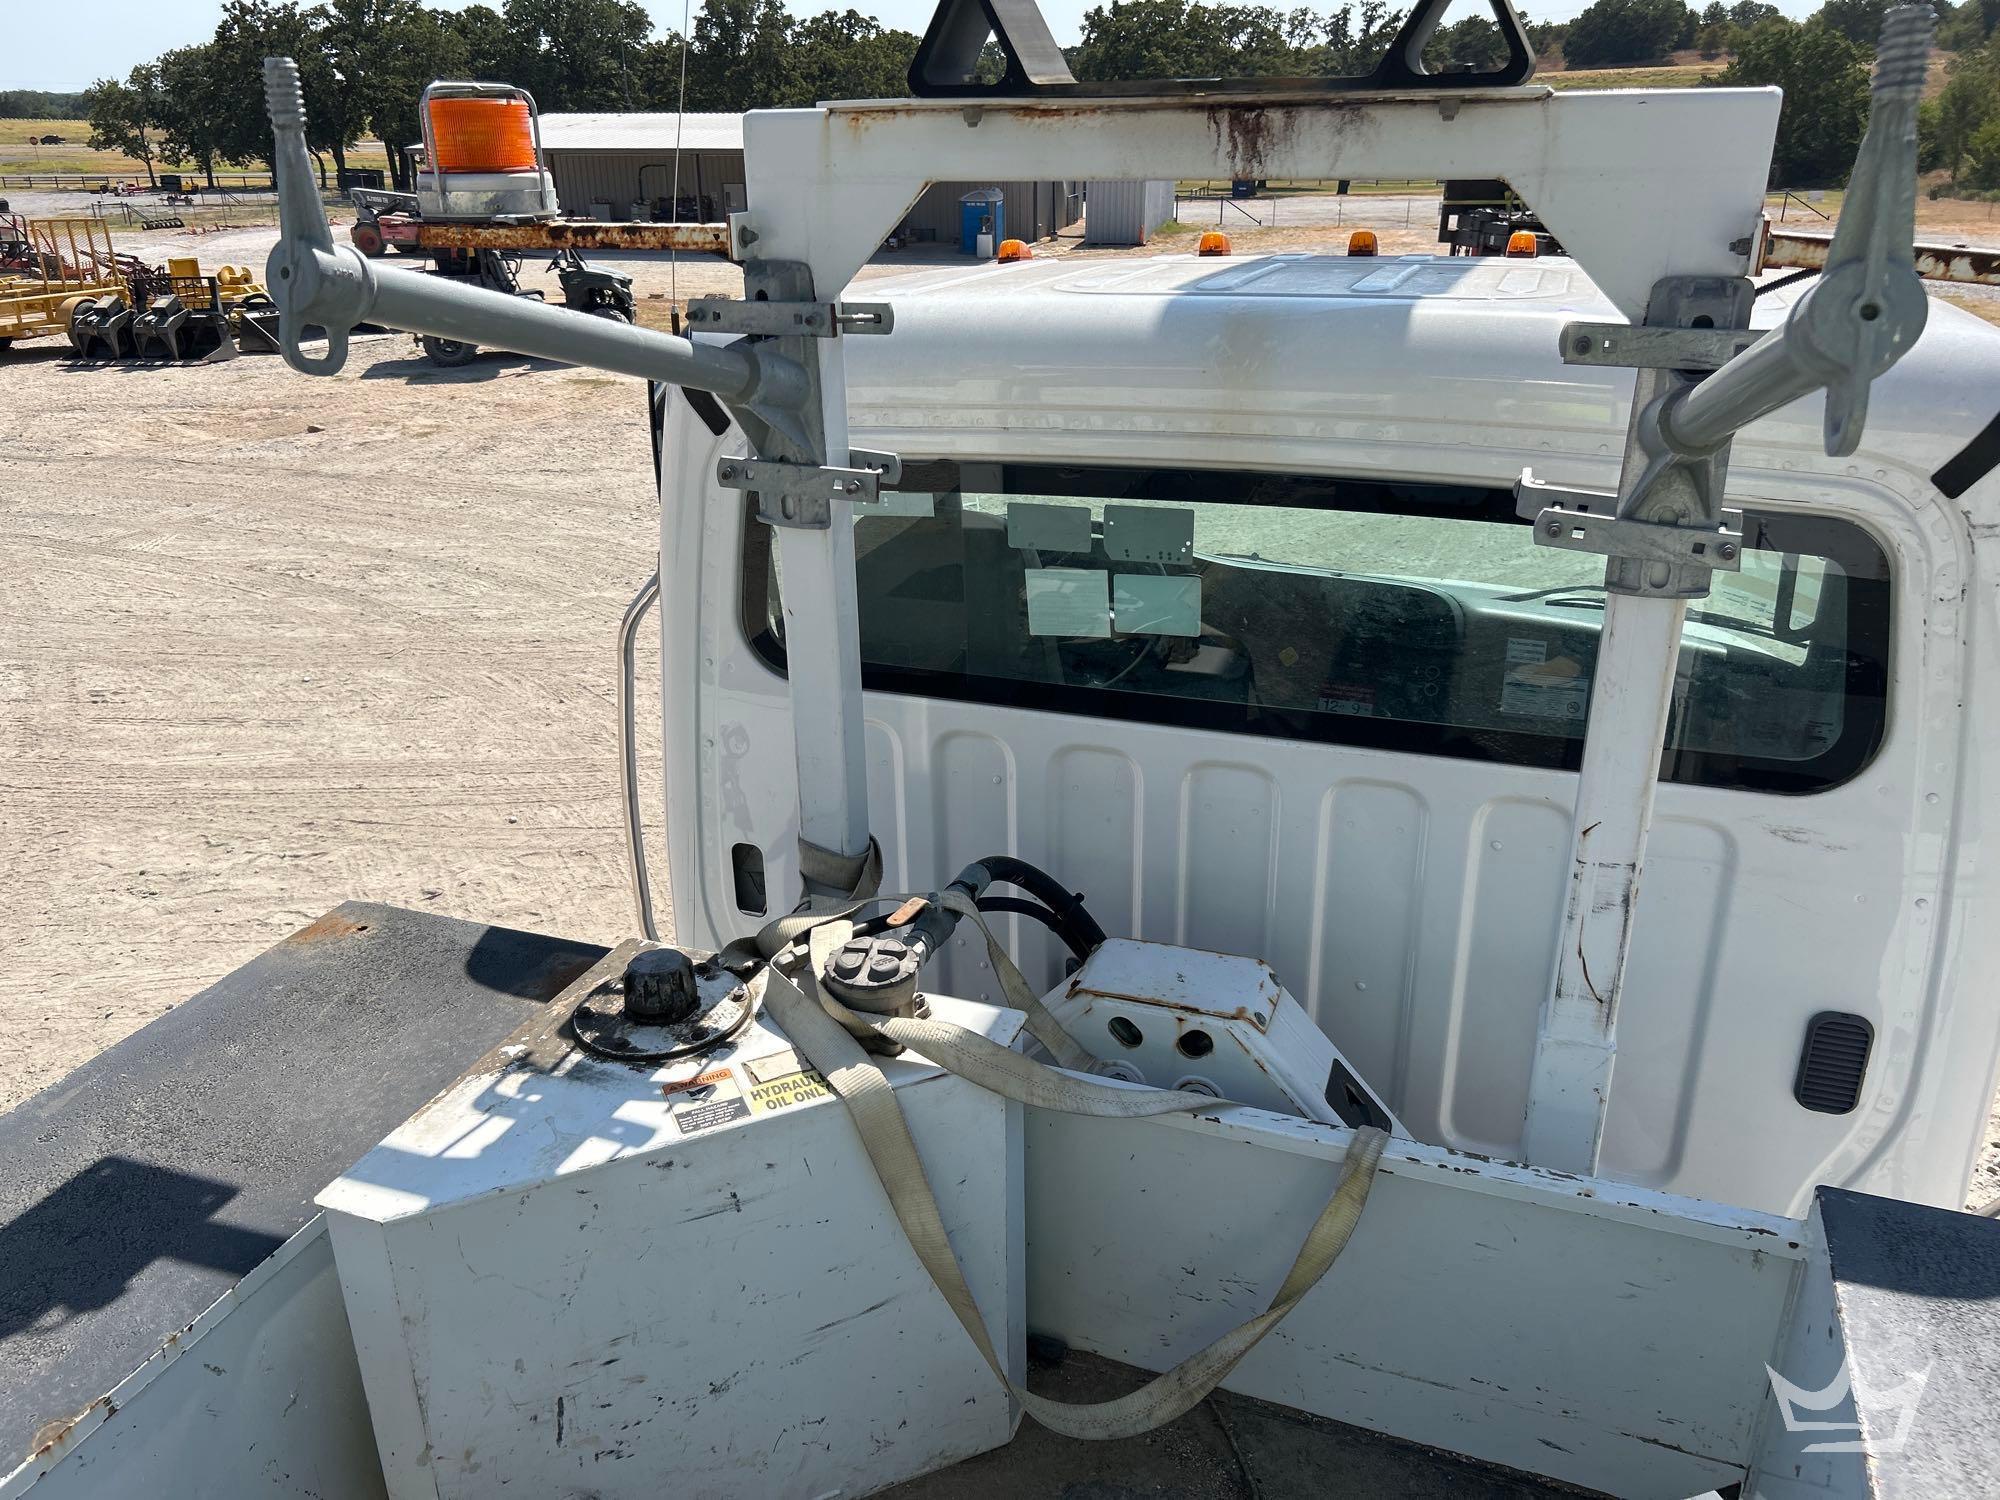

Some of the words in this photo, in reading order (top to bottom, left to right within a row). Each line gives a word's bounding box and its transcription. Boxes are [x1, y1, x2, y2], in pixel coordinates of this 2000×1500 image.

[677, 1071, 728, 1089] WARNING
[765, 1096, 792, 1110] OIL
[794, 1085, 827, 1102] ONL
